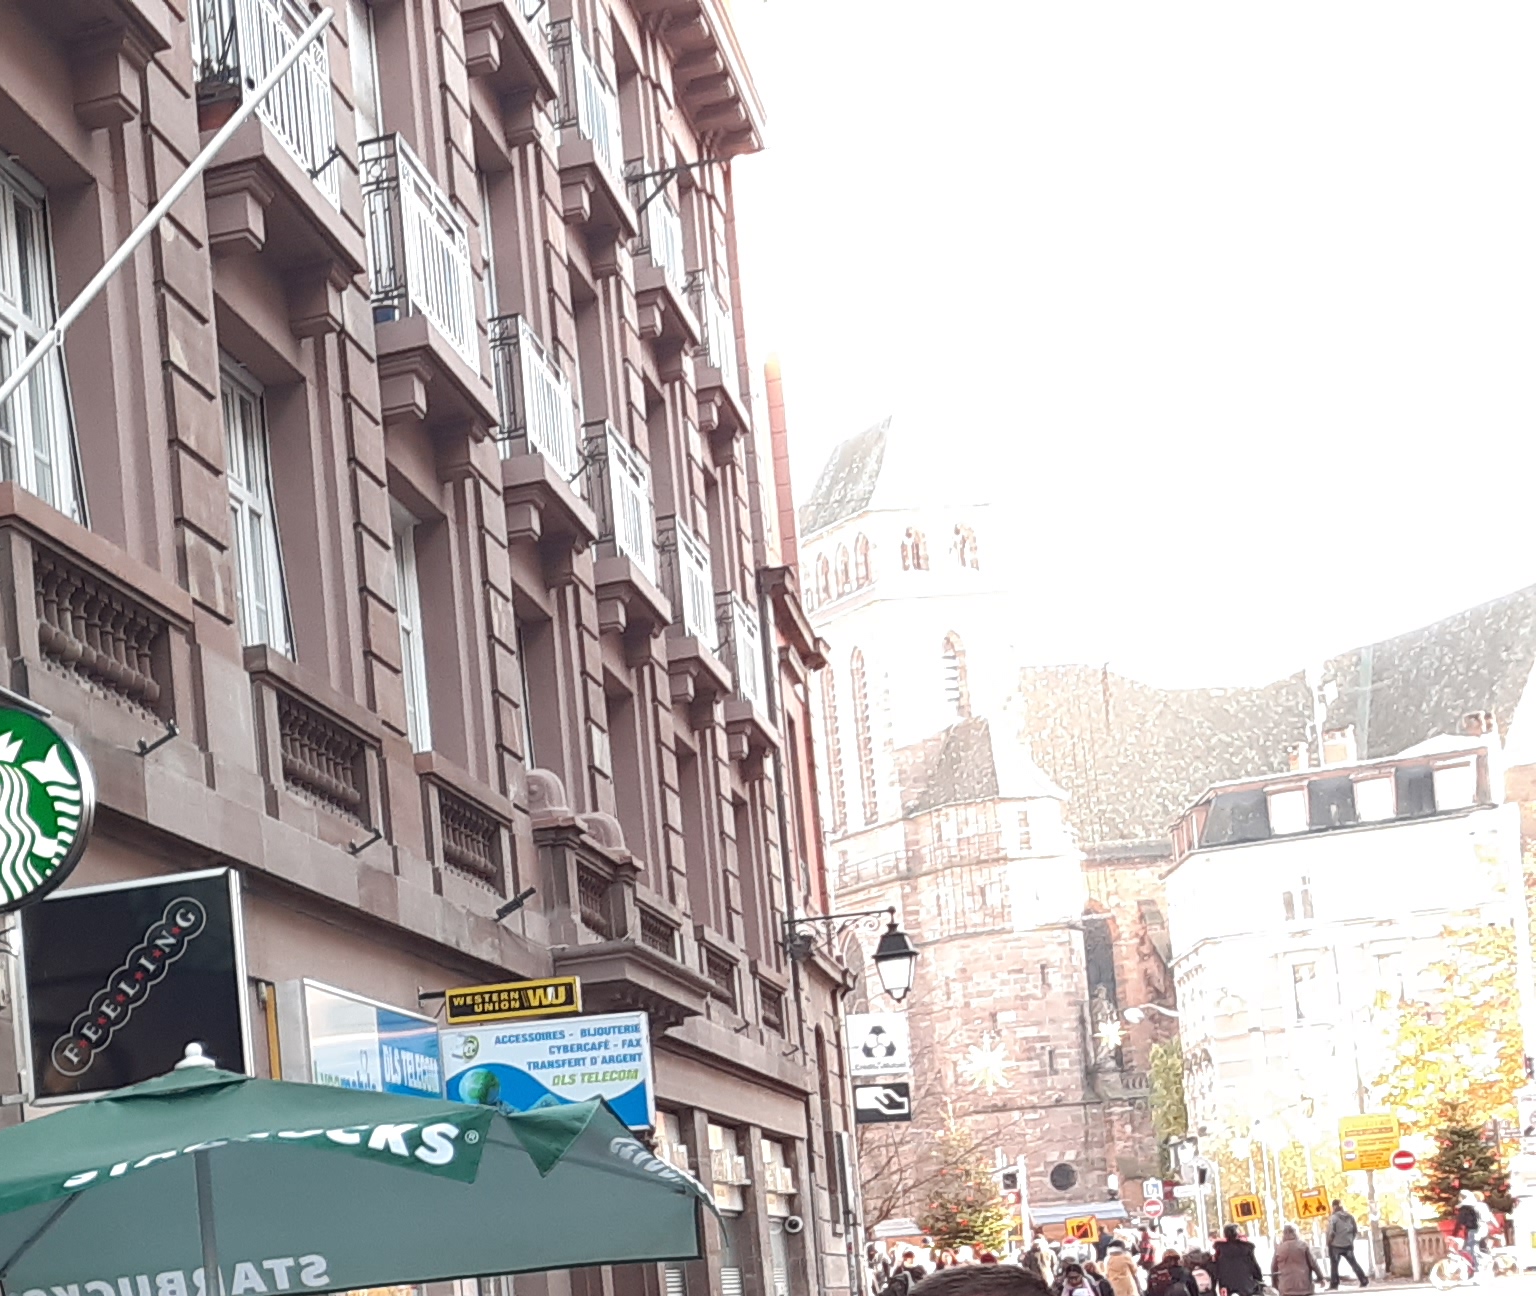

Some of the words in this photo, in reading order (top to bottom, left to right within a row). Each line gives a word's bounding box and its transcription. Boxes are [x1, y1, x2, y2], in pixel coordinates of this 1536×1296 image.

[61, 907, 197, 1066] FEELING
[452, 990, 520, 1006] WESTERN
[527, 986, 566, 1007] WU
[473, 1000, 520, 1013] UNION
[494, 1029, 566, 1045] ACCESSOIRES
[580, 1023, 641, 1038] BIJOUTERIE
[548, 1038, 610, 1056] CYBERCAFÉ
[621, 1038, 642, 1049] FAX
[526, 1057, 587, 1072] TRANSFERT
[581, 1068, 639, 1084] TELECOM
